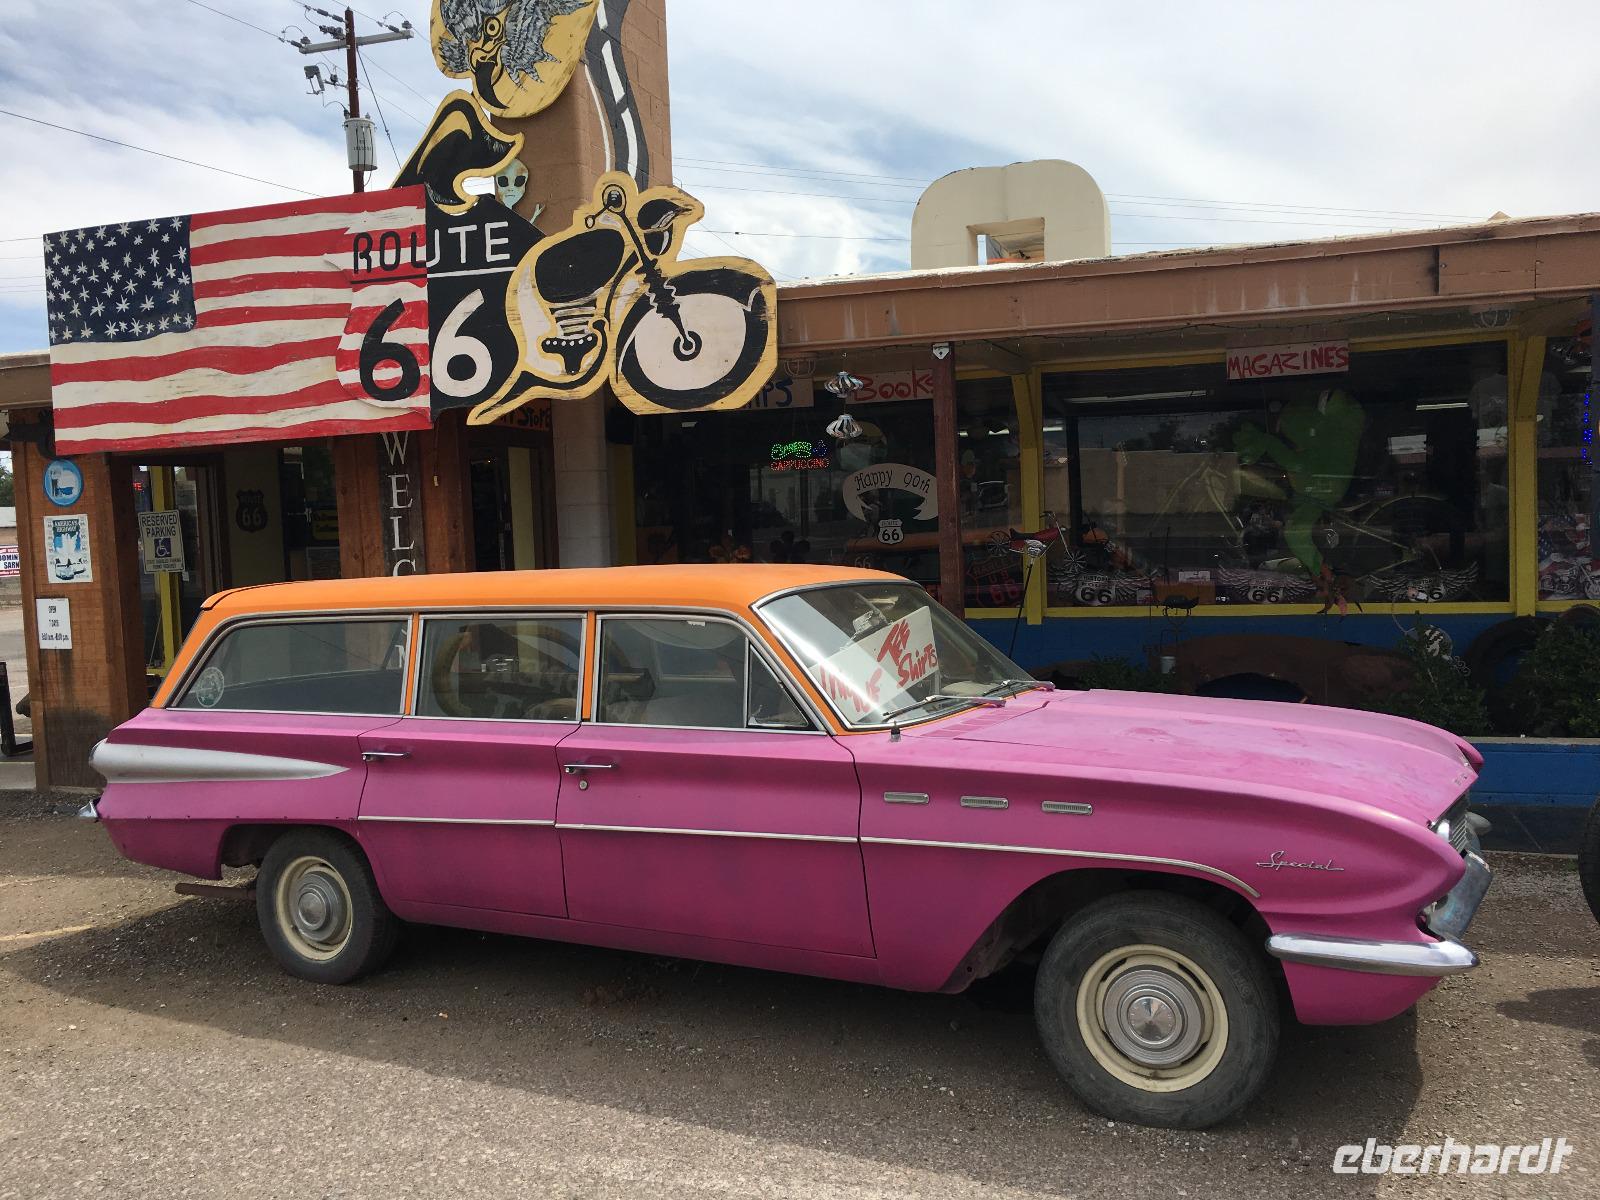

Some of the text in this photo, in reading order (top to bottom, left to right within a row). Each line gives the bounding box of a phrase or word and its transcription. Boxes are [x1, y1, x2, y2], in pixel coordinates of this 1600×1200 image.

[353, 221, 510, 274] ROUTE
[359, 288, 493, 401] 66
[1227, 345, 1349, 378] MAGAZINES
[855, 470, 931, 494] Happy 90th
[142, 514, 178, 527] RESERVED
[242, 507, 262, 527] 66
[146, 526, 177, 537] PARKING
[882, 528, 900, 541] 66
[0, 554, 18, 562] OMIN
[1081, 587, 1112, 603] 66
[1252, 590, 1280, 603] 66
[1256, 850, 1345, 871] Special
